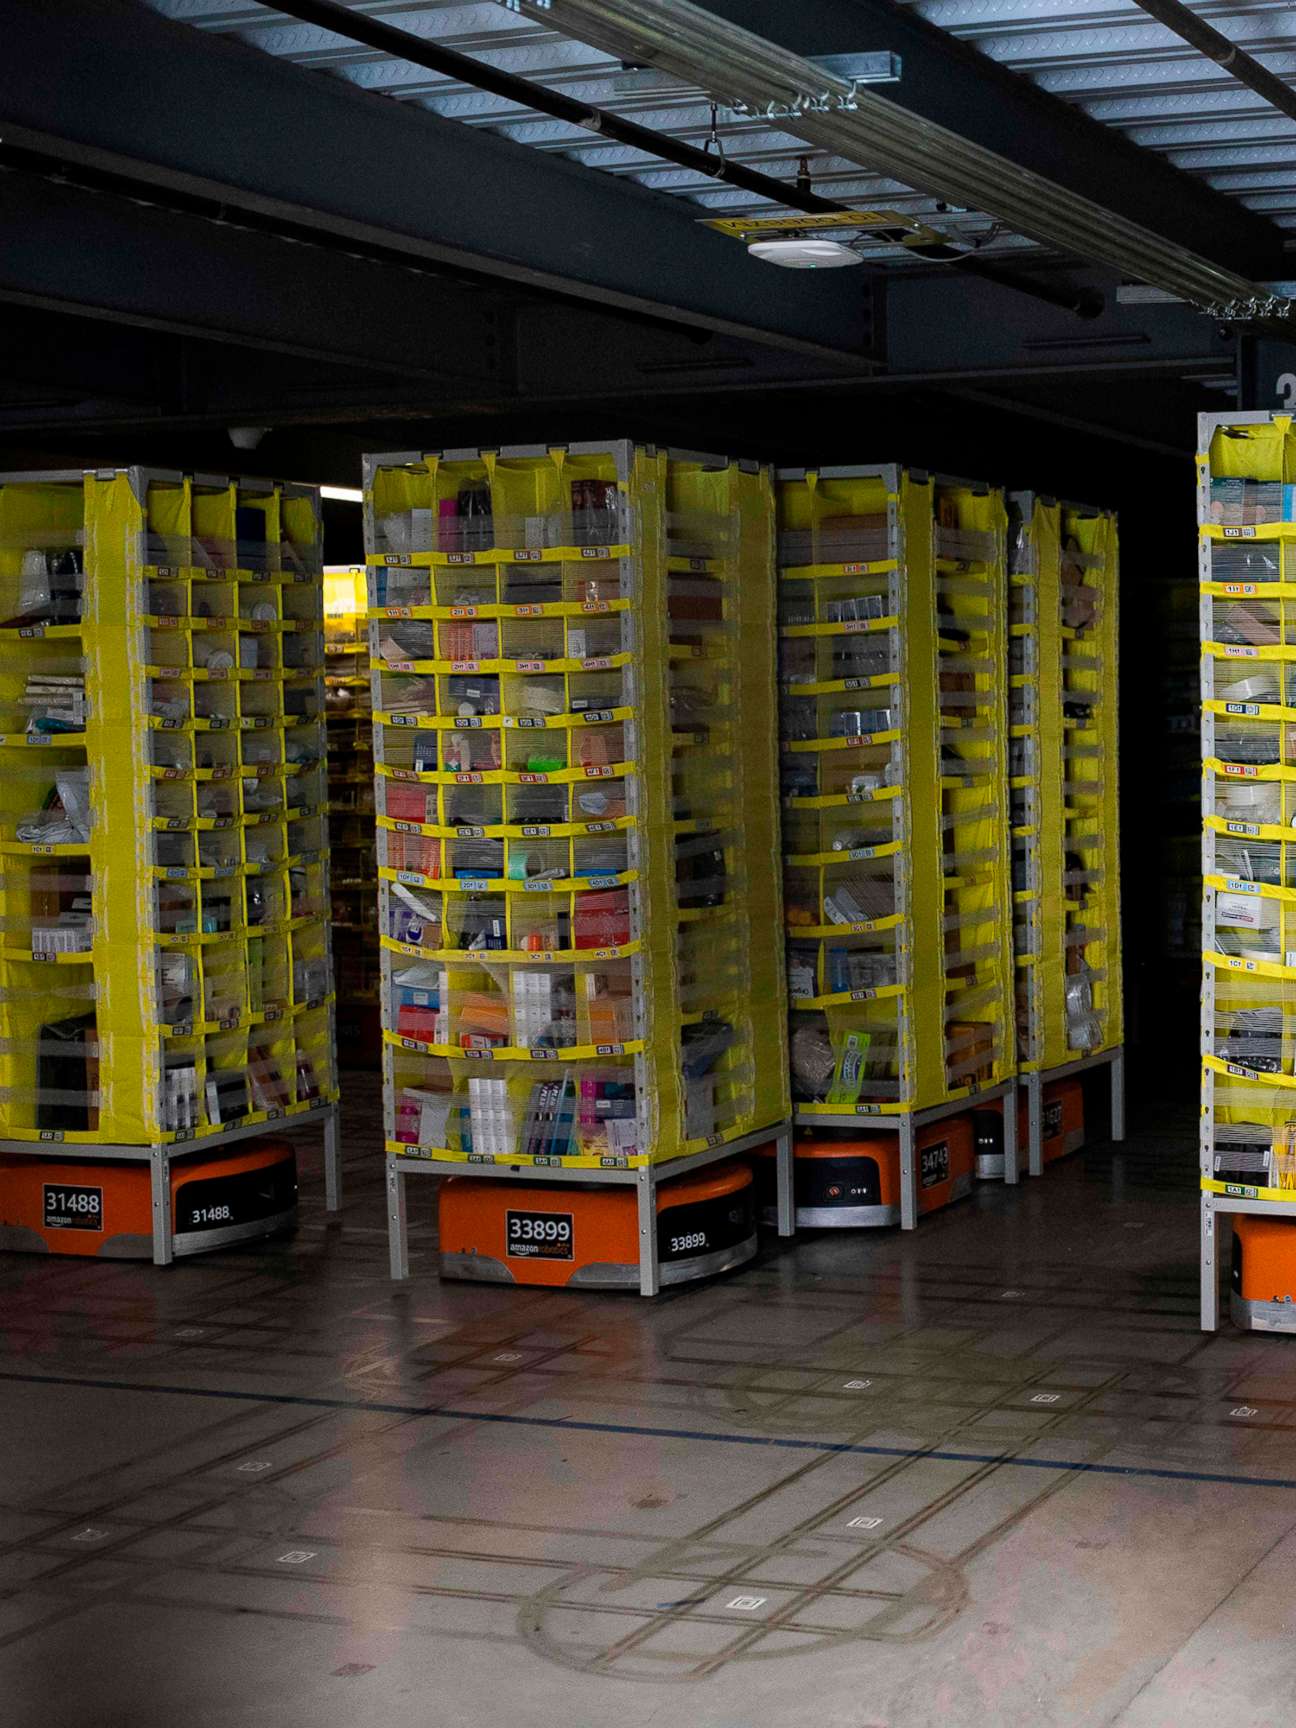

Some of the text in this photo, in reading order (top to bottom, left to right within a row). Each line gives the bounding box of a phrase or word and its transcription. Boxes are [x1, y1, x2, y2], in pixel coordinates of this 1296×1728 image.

[921, 1146, 948, 1172] 34743
[46, 1192, 100, 1213] 31488
[192, 1205, 230, 1223] 31488
[510, 1219, 570, 1240] 33899
[671, 1232, 706, 1252] 33899
